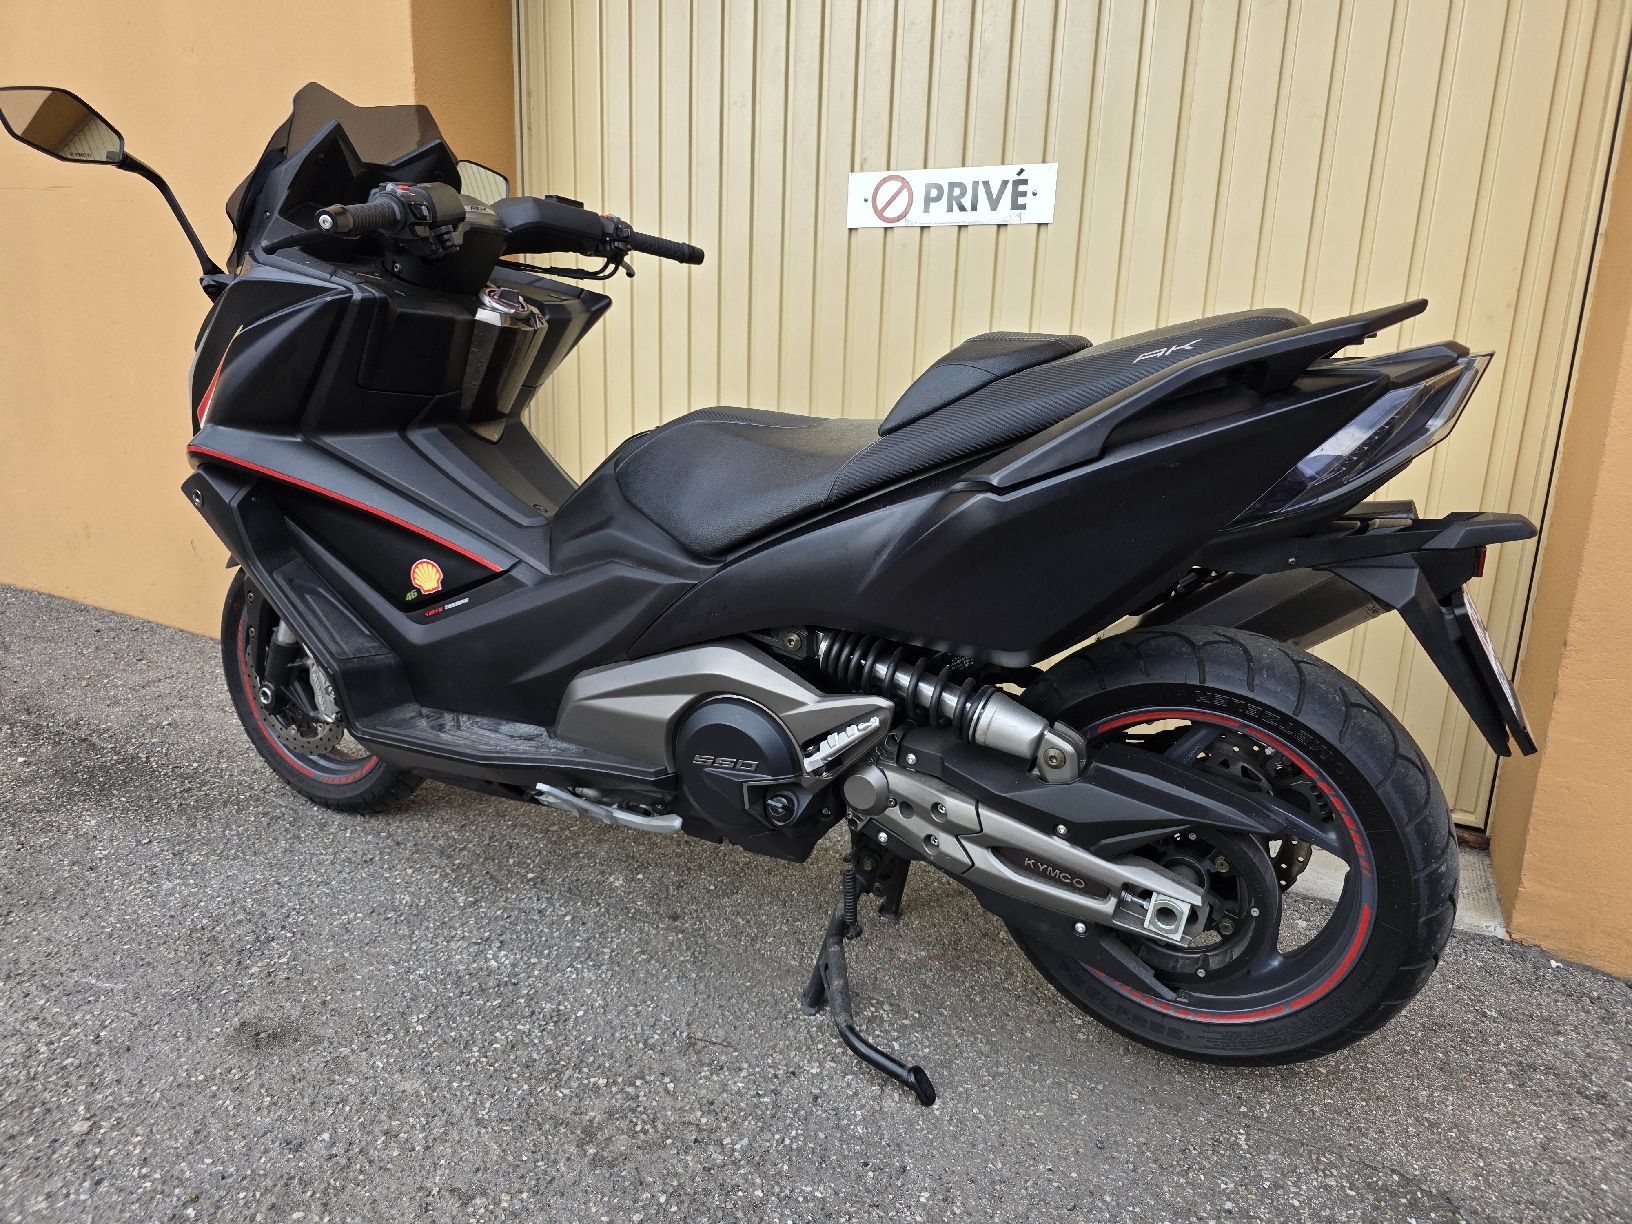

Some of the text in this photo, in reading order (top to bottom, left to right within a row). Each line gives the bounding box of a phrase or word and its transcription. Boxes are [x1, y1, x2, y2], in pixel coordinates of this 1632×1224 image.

[922, 167, 1029, 214] PRIVÉ
[406, 590, 418, 600] 46
[692, 754, 759, 772] 550
[1024, 857, 1086, 889] KYMCO
